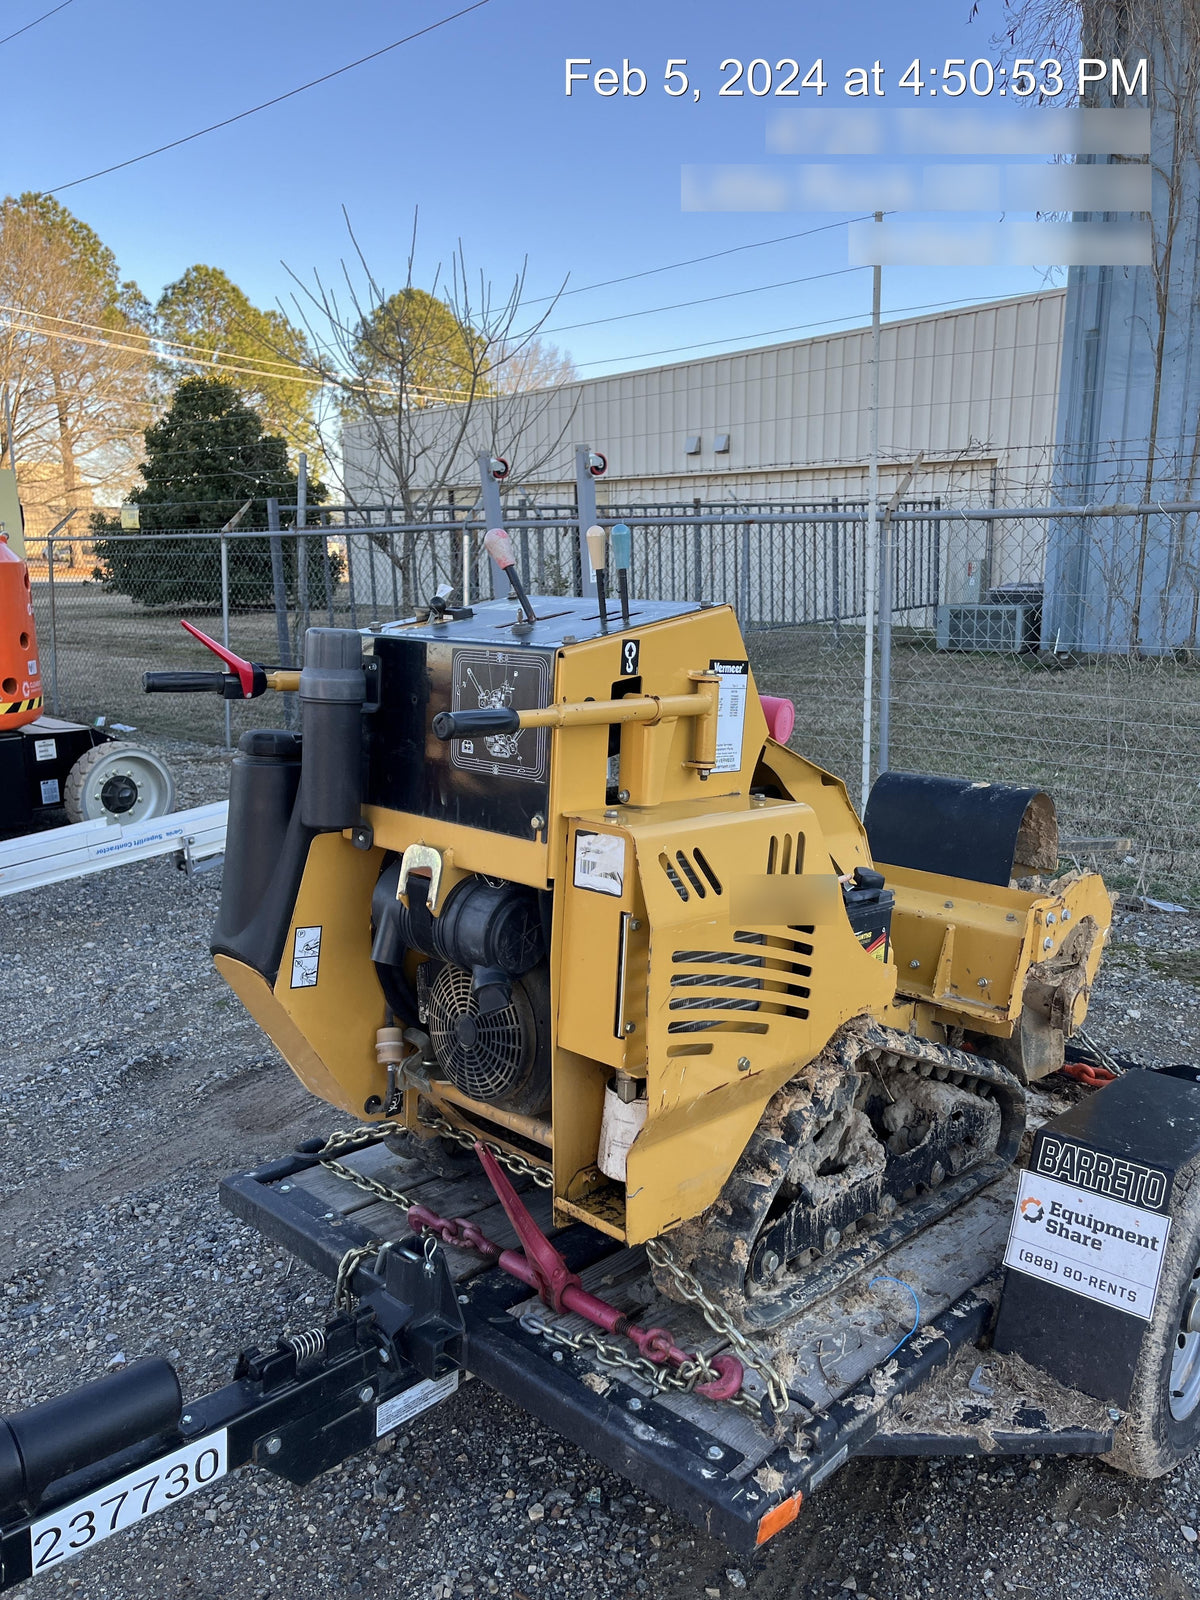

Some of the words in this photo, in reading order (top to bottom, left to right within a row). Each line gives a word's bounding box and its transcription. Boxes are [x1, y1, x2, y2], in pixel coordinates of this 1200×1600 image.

[714, 662, 742, 673] Vermeer
[96, 841, 133, 855] Contractor
[1037, 1137, 1167, 1208] BARRETO
[1045, 1219, 1103, 1251] Share
[1048, 1200, 1160, 1252] Equipment
[1018, 1248, 1059, 1274] (888)
[1063, 1266, 1137, 1302] 80-RENTS
[34, 1449, 219, 1568] 237730
